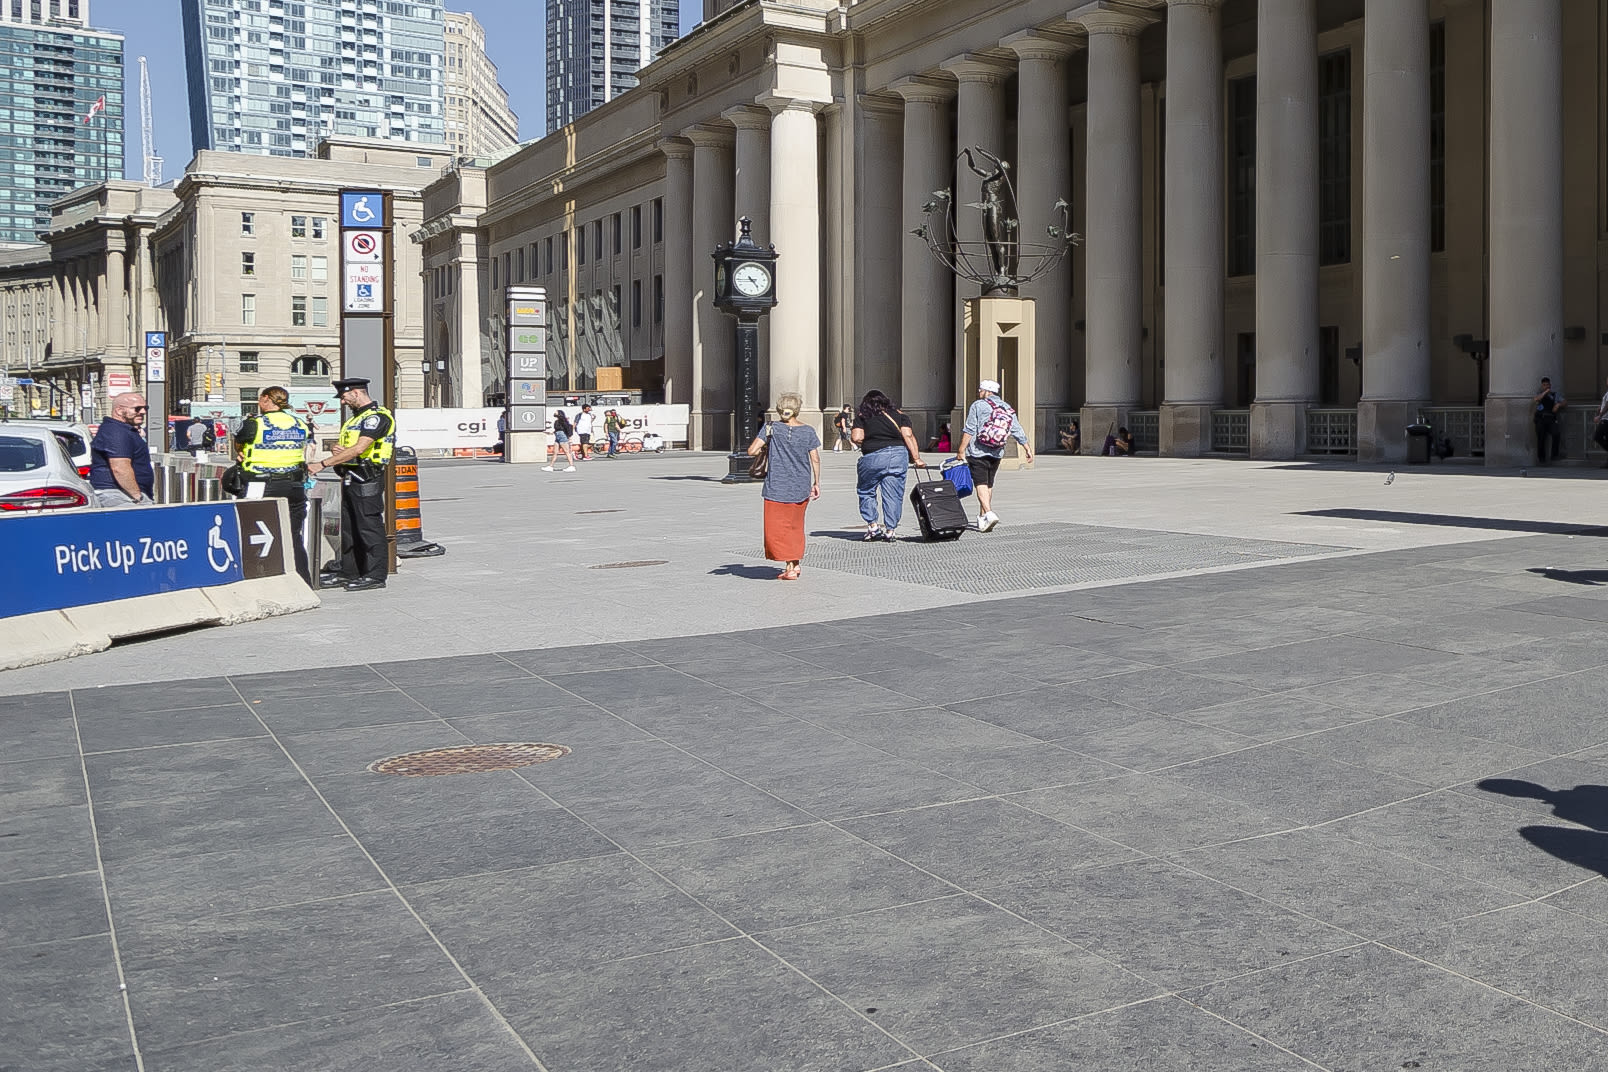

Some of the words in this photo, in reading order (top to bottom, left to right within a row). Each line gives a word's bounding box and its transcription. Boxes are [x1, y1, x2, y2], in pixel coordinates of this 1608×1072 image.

[360, 265, 369, 273] NO
[520, 357, 538, 368] UP
[457, 418, 487, 434] cgi
[625, 415, 648, 430] cgi
[55, 541, 102, 574] Pick
[105, 540, 136, 574] Up
[139, 537, 189, 564] Zone
